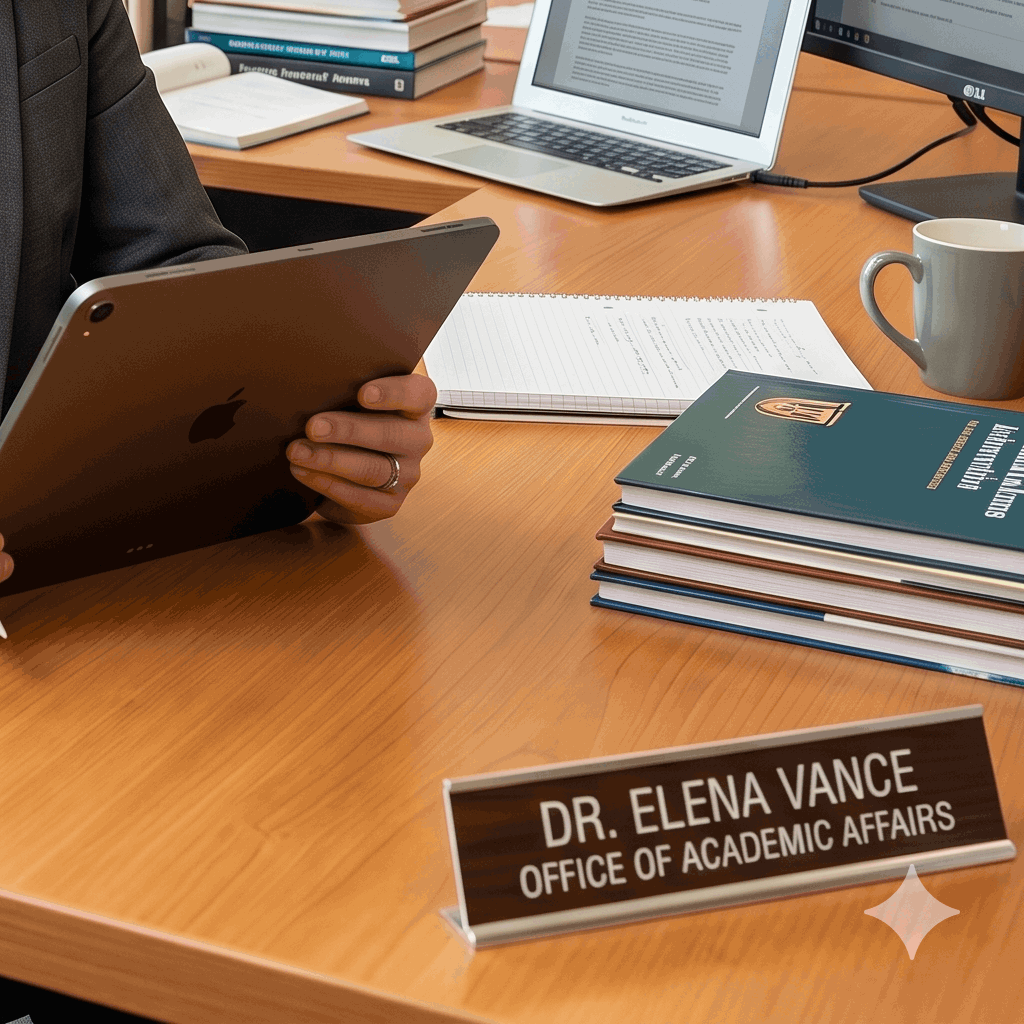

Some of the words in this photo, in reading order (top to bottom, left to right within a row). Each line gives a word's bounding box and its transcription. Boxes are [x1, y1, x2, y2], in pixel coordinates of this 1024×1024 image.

[539, 794, 618, 849] DR.
[628, 771, 773, 835] ELENA
[776, 748, 919, 811] VANCE
[519, 851, 628, 899] OFFICE
[633, 843, 673, 882] OF
[681, 819, 834, 874] ACADEMIC
[842, 800, 956, 848] AFFAIRS
